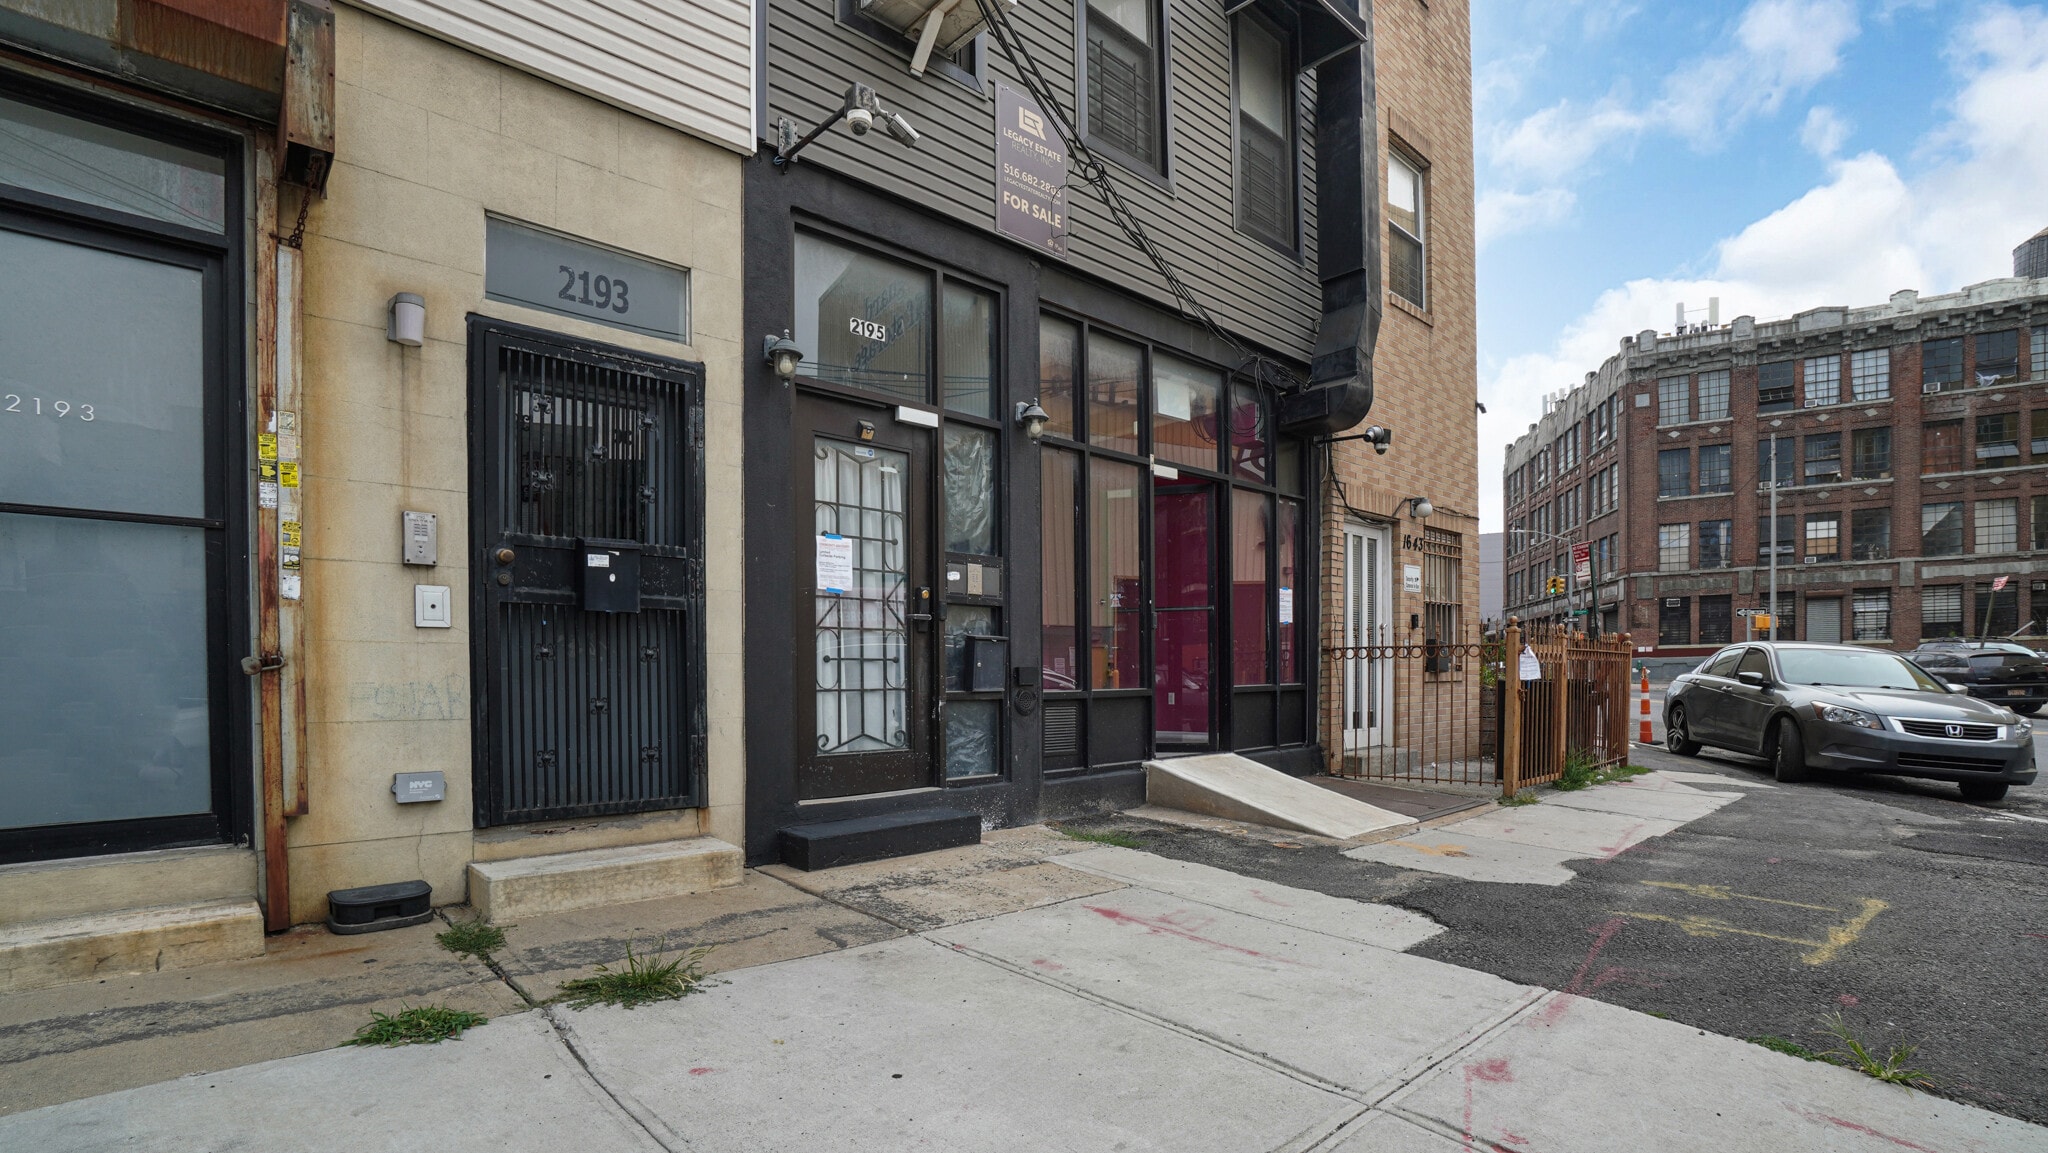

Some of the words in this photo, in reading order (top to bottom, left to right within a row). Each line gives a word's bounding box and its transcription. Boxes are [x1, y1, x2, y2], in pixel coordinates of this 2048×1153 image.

[1003, 127, 1034, 149] LEGACY
[1035, 143, 1062, 163] ESTATE
[1003, 190, 1030, 215] FOR
[1032, 204, 1062, 229] SALE
[558, 265, 629, 314] 2193
[851, 318, 885, 341] 2195
[4, 393, 95, 422] 2193
[1403, 534, 1424, 551] 1643
[409, 780, 433, 789] NYC
